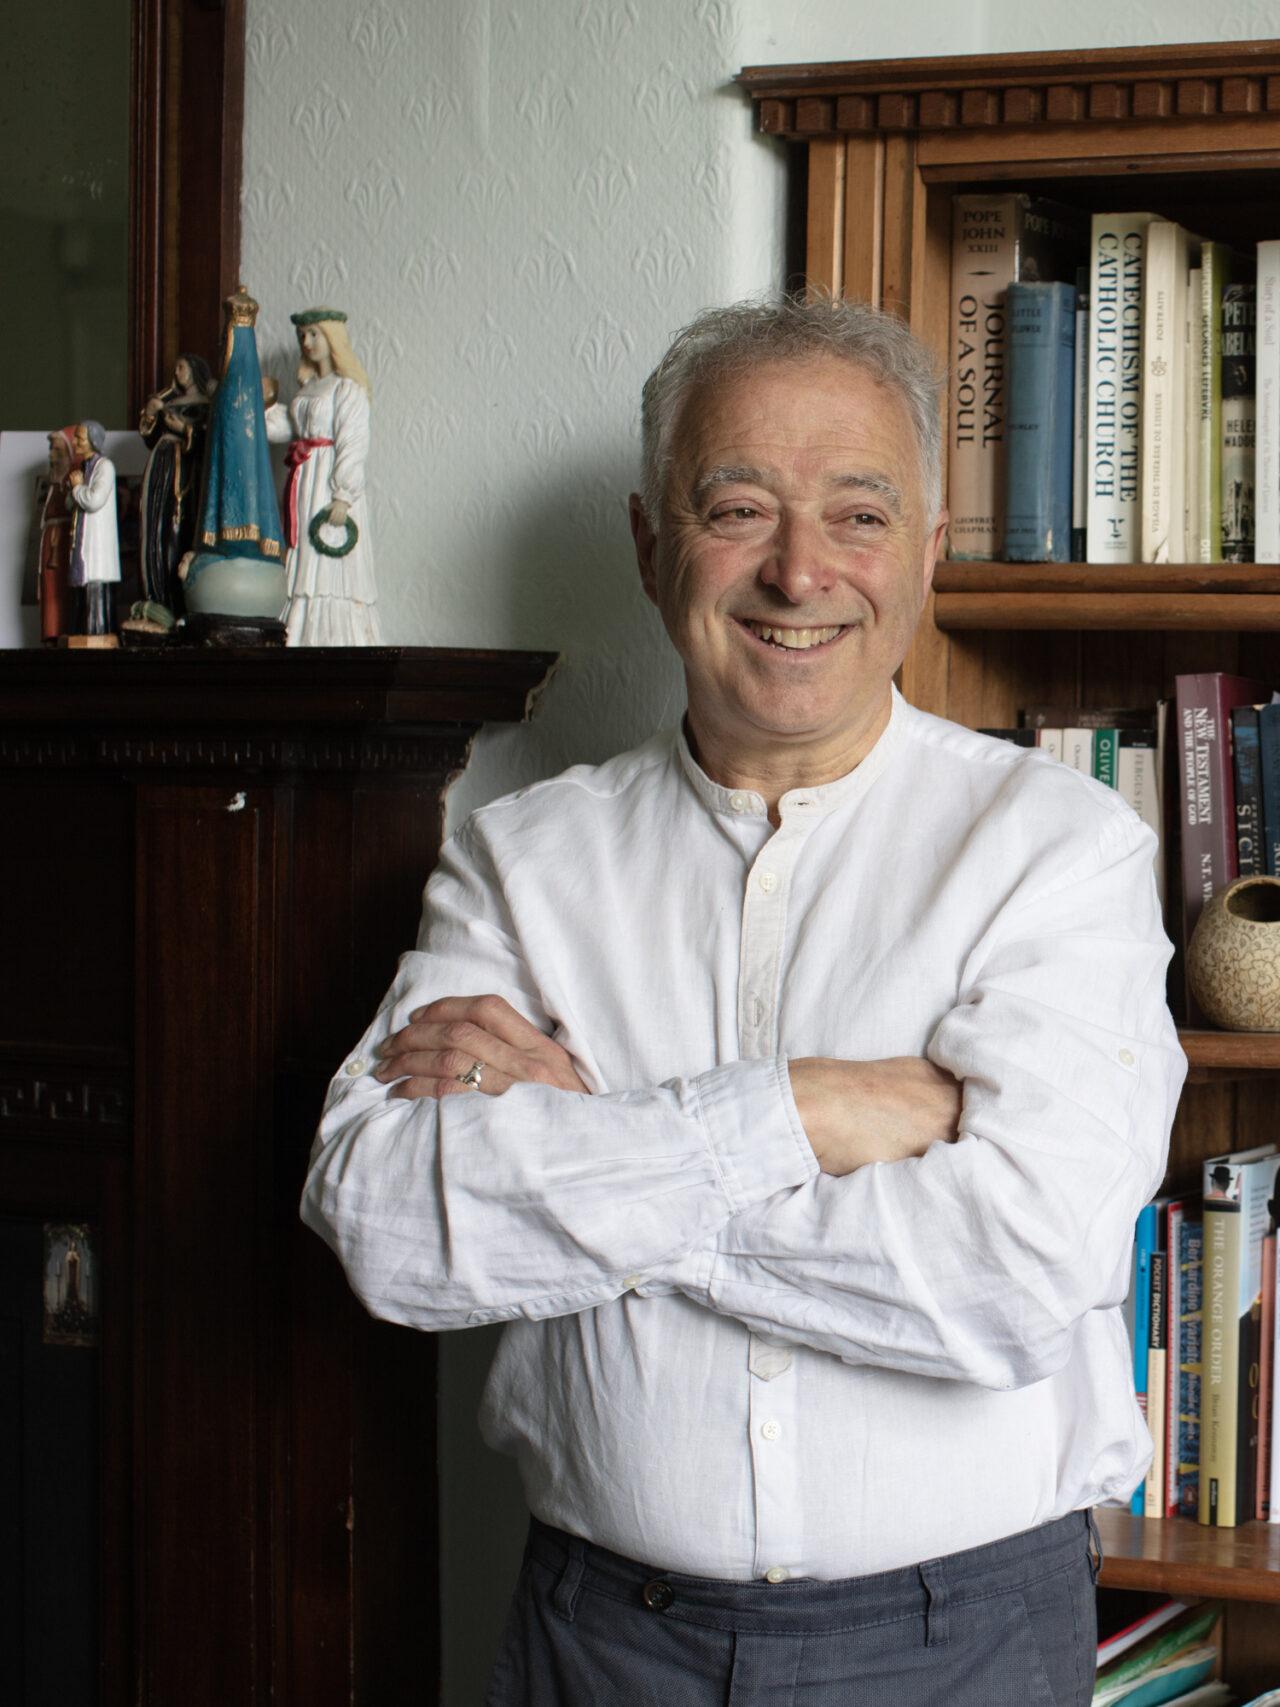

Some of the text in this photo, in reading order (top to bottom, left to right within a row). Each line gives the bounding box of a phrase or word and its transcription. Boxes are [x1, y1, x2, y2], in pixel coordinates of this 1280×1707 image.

[962, 227, 1006, 240] JOHN
[964, 211, 1000, 223] POPE
[968, 244, 997, 254] XXIII
[956, 296, 978, 449] OF A SOUL
[982, 303, 1006, 448] JOURNAL
[1095, 233, 1118, 497] CATHOLIC CHURCH
[1119, 233, 1141, 502] CATECHISM OF THE
[1183, 708, 1196, 825] AND THE PEOPLE OF GOD
[1195, 707, 1211, 824] NEW TESTAMENT
[1208, 718, 1216, 740] THE
[1151, 1258, 1162, 1347] POCKET DICTIONARY
[1210, 1219, 1225, 1385] THE ORANGE ORDER
